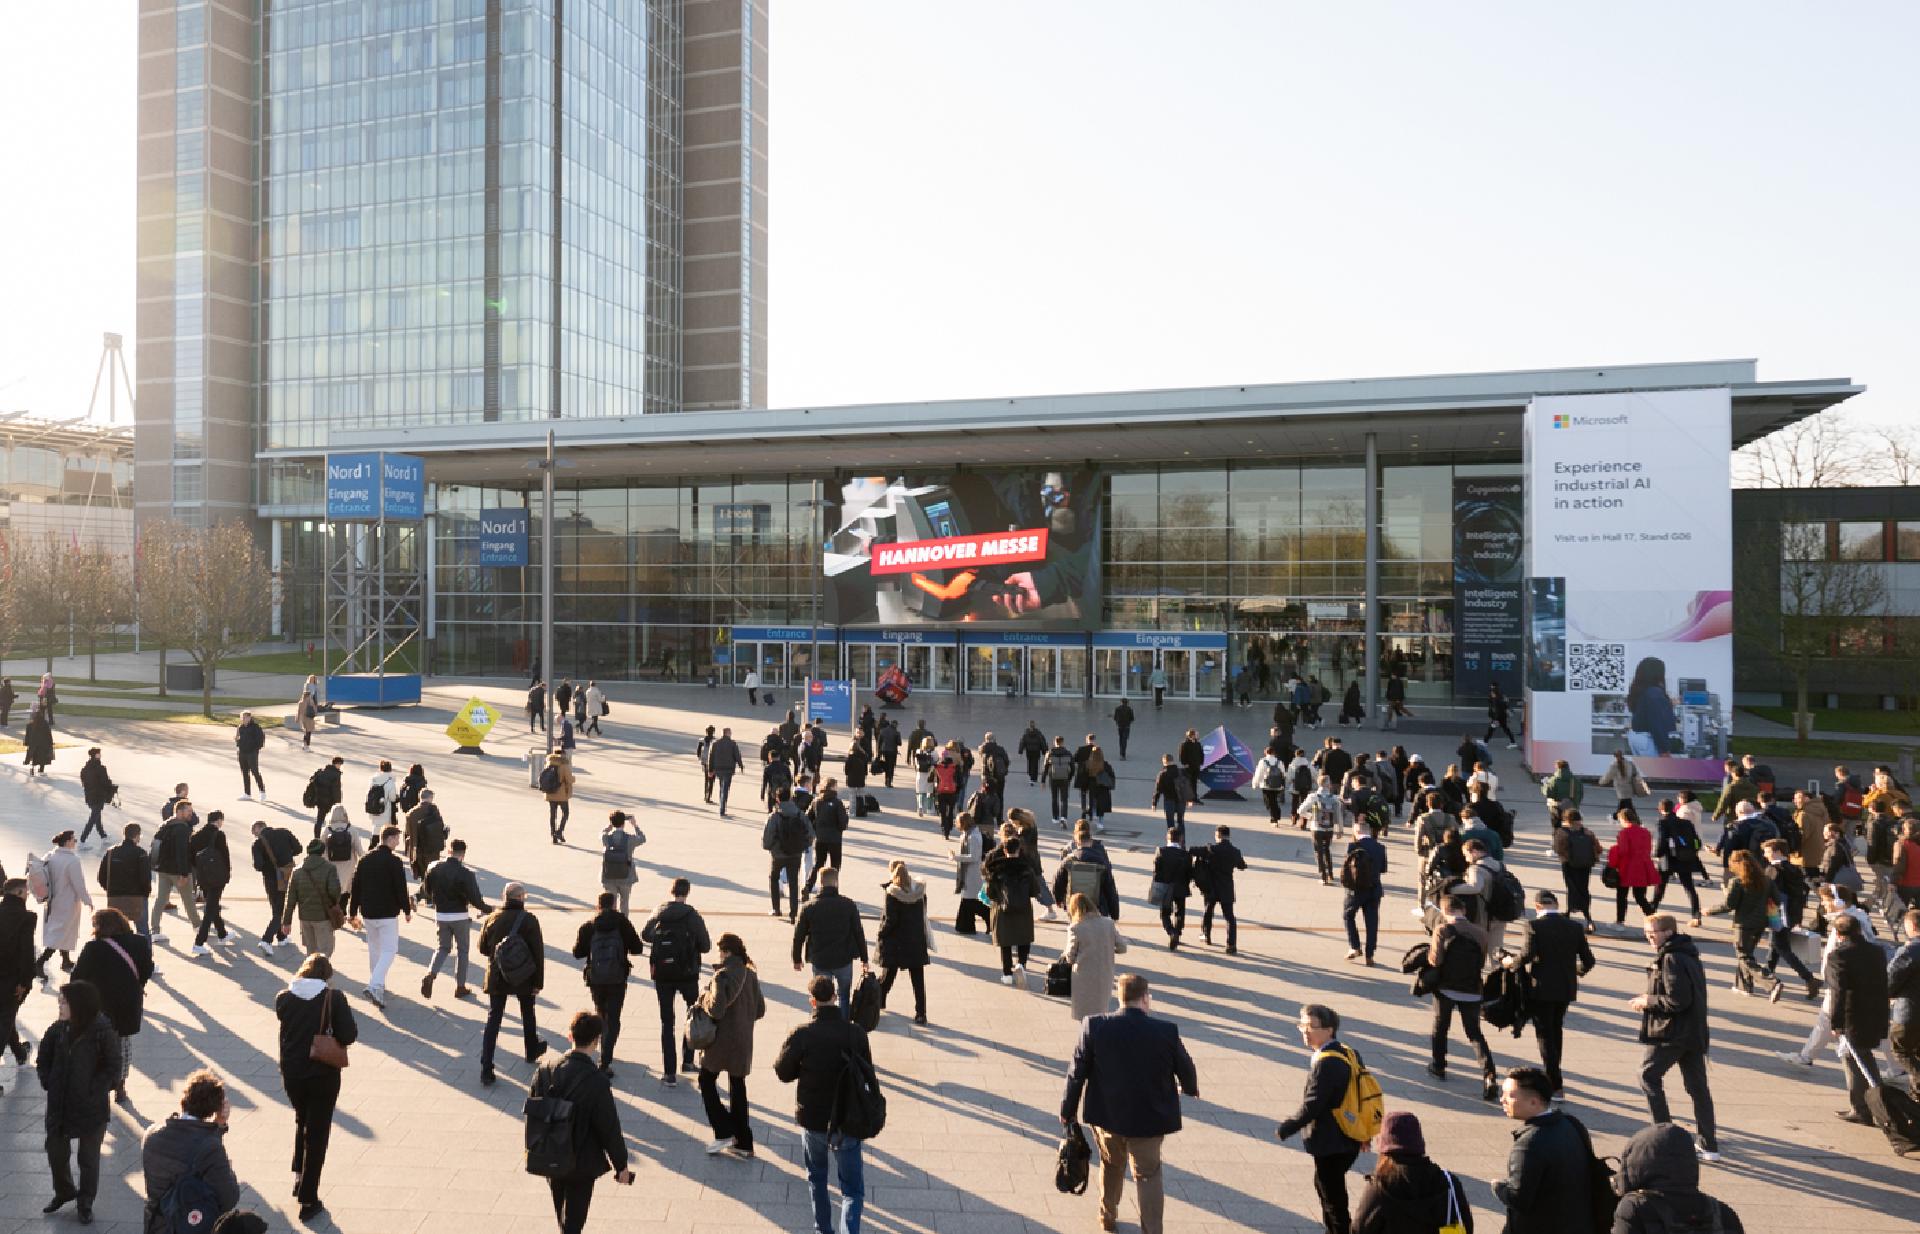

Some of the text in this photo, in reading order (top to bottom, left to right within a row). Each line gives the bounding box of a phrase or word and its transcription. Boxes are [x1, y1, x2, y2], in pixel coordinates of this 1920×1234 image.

[1573, 414, 1628, 426] Microsoft
[328, 462, 371, 480] Nord 1
[384, 464, 418, 480] Nord 1
[1554, 461, 1642, 476] Experience
[1554, 478, 1651, 491] industrial AI
[328, 488, 369, 503] Eingang
[384, 488, 415, 504] Eingang
[328, 503, 371, 514] Entrance
[384, 502, 417, 514] Entrance
[1554, 496, 1624, 509] in action
[482, 520, 526, 534] Nord 1
[1555, 533, 1577, 543] Visit
[1578, 535, 1589, 543] us
[1591, 533, 1600, 542] in
[1602, 533, 1622, 542] Hall
[1624, 533, 1638, 543] 17,
[1639, 532, 1669, 542] Stand
[482, 542, 515, 552] Eingang
[879, 535, 1039, 566] HANNOVER MESSE
[481, 553, 518, 562] Entrance
[1464, 589, 1518, 600] Intelligent
[766, 628, 807, 640] Entrance
[882, 630, 922, 643] Eingang
[1003, 632, 1049, 643] Entrance
[1136, 633, 1182, 646] Eingang
